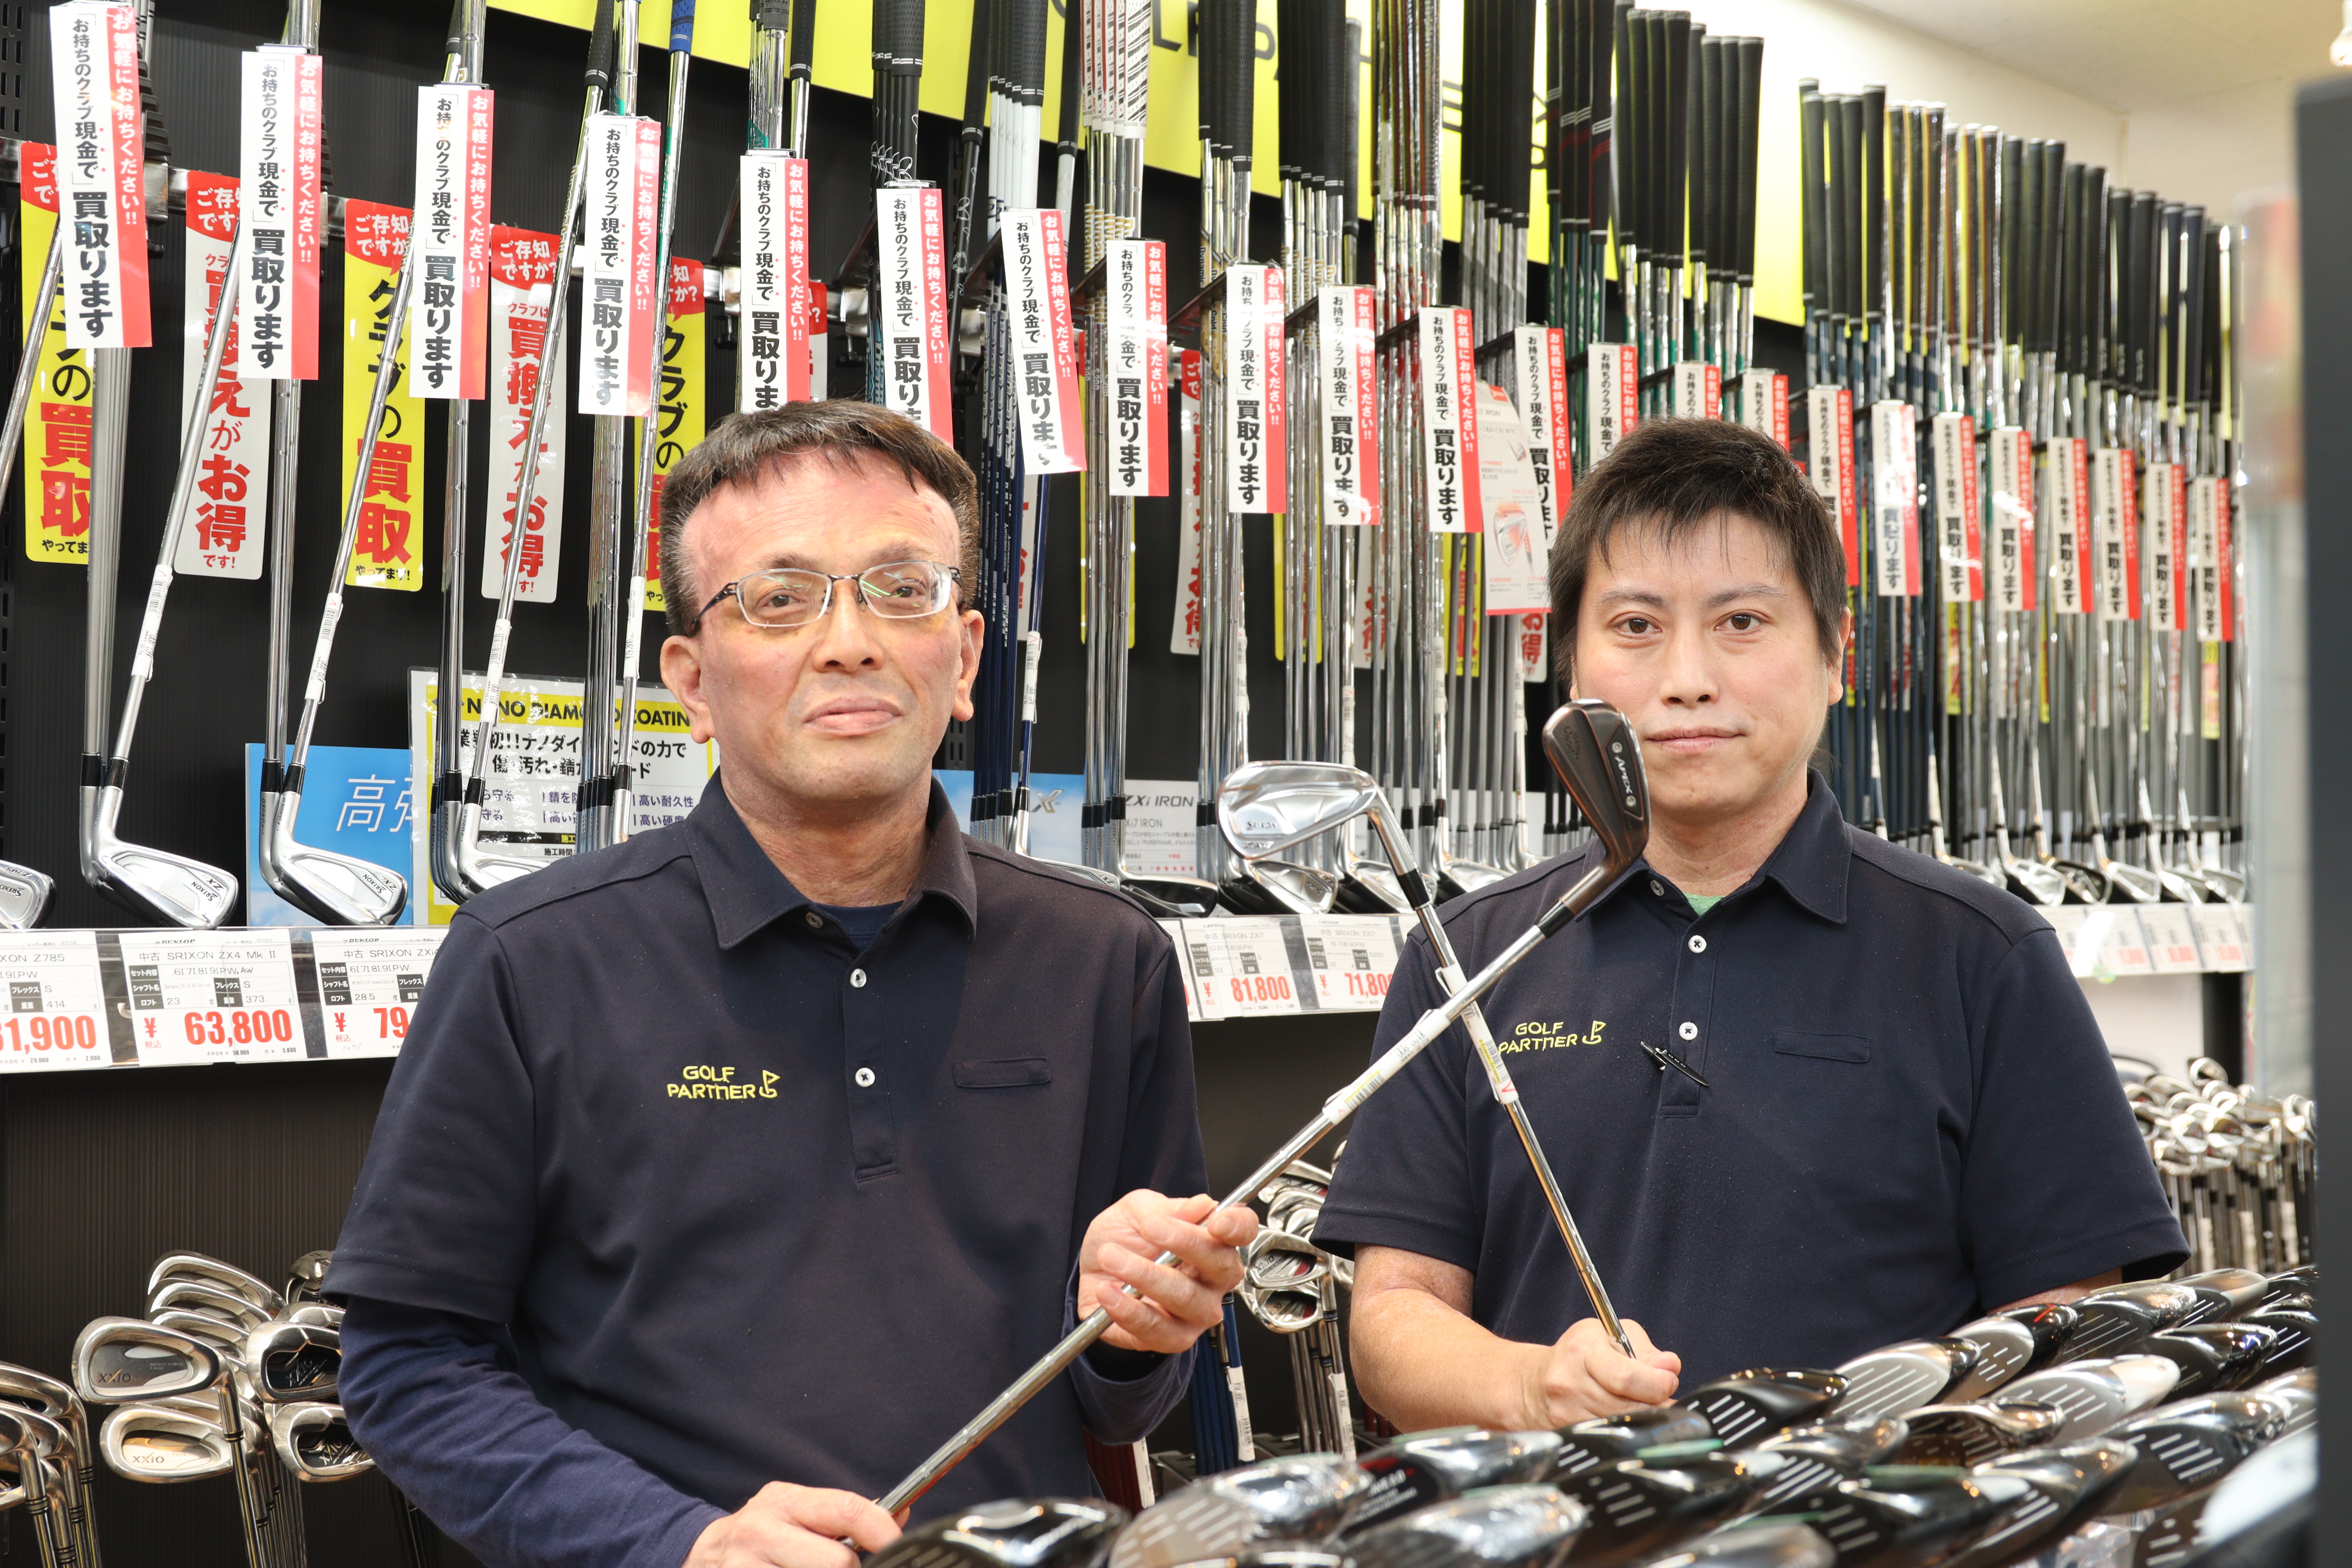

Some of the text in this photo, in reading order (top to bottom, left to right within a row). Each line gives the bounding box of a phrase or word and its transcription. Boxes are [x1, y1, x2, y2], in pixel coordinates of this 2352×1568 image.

[113, 14, 140, 225] お気軽にお持ちください!!
[298, 60, 317, 263] お気軽にお持ちください!!
[197, 188, 240, 208] ご存
[468, 95, 489, 288] お気軽にお持ちください!!
[356, 215, 410, 235] ご存知
[635, 126, 657, 310] お気軽にお持ちください!!
[357, 237, 407, 257] ですか
[500, 240, 550, 259] ご存知
[789, 164, 805, 340] お気軽にお持ちください!!
[73, 192, 113, 338] 買取ります
[924, 194, 945, 364] お気軽にお持ちください!!
[252, 230, 285, 368] 買取ります
[1044, 215, 1072, 378] お気軽にお持ちください!!
[422, 256, 456, 388] 買取ります
[752, 311, 780, 409] 買取りま
[1622, 350, 1635, 429] お気軽にお持ち
[42, 539, 88, 554] やってま
[203, 554, 235, 568] です!
[519, 581, 534, 593] す!
[467, 697, 690, 727] NNO DIAM OATIN
[1614, 755, 1633, 795] APEX
[639, 794, 694, 808] 高い耐久性
[1155, 796, 1194, 807] IRON
[550, 811, 576, 824] 高い
[1125, 818, 1163, 827] Xi7 IRON
[0, 885, 25, 897] SRIXO
[191, 882, 218, 901] SRIXON
[363, 874, 387, 894] SRIXON
[34, 954, 65, 962] Z785
[140, 952, 160, 962] 中古
[167, 951, 213, 960] SRIXON
[345, 949, 363, 959] 中古
[370, 949, 412, 957] SRIXON
[1230, 976, 1290, 1004] 81,800
[0, 1015, 96, 1054] 1,900
[184, 1009, 292, 1047] 63,800
[1516, 1022, 1564, 1035] GOLF
[145, 1040, 162, 1049] 税込
[1499, 1034, 1577, 1055] PARTNER
[682, 1065, 735, 1083] GOLF
[667, 1083, 756, 1100] PARTNER
[98, 1368, 132, 1383] XXIO
[132, 1452, 165, 1464] XXIO
